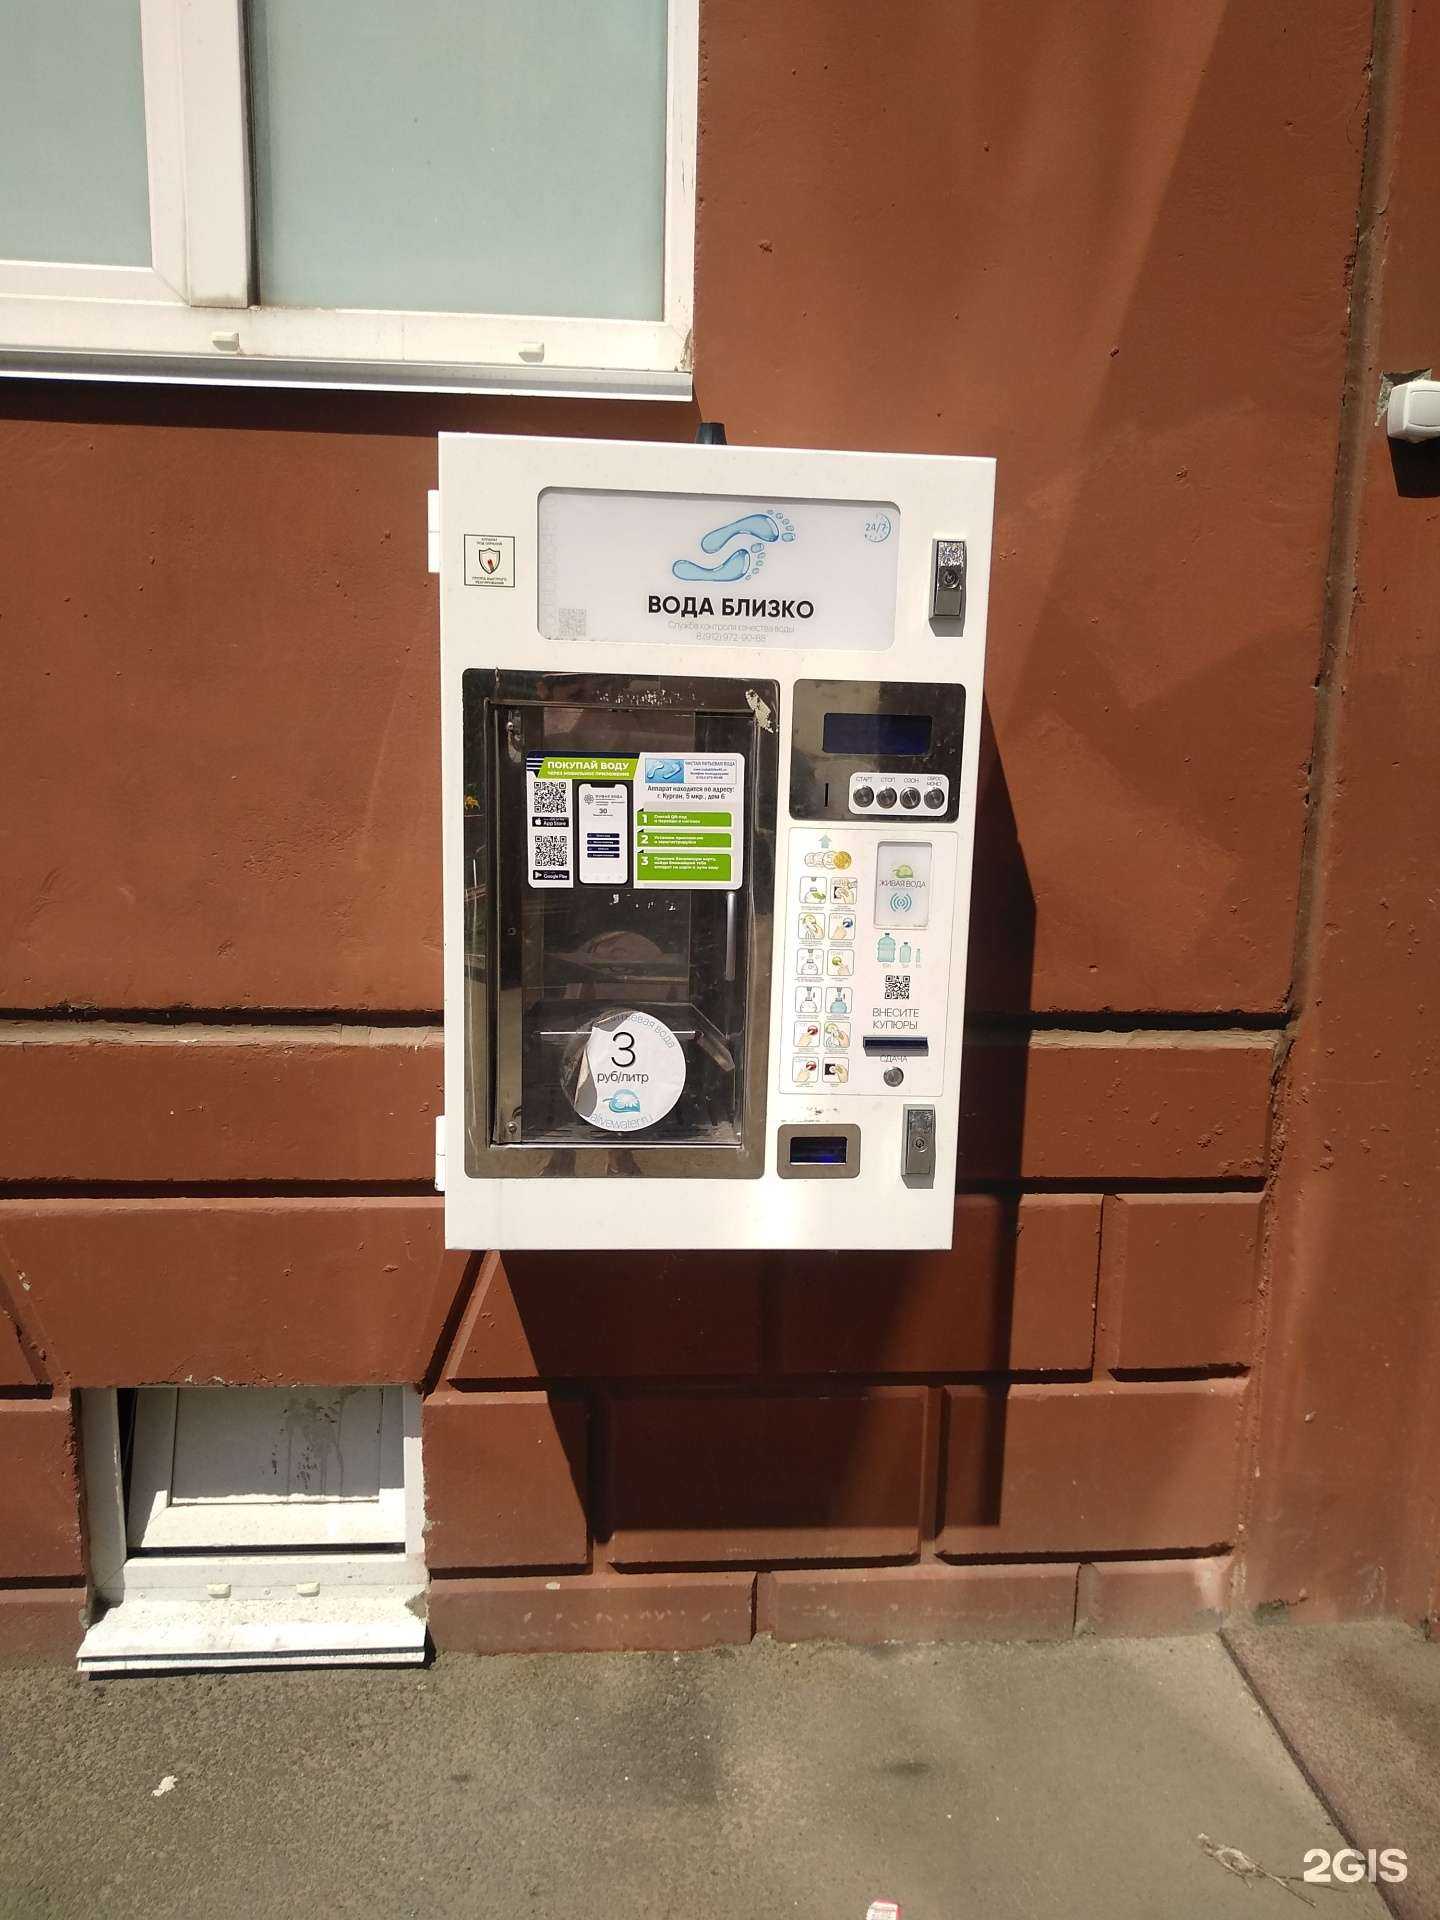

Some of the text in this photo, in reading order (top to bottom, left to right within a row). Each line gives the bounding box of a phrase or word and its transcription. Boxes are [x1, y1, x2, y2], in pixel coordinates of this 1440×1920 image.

[865, 522, 888, 533] 24/7
[648, 595, 815, 619] ВОДА БЛИЗКО
[547, 760, 630, 771] ПОКУПАЙ ВОДУ
[641, 815, 648, 824] 1
[641, 834, 649, 844] 2
[641, 856, 649, 866] 3
[879, 879, 927, 889] ЖИВАЯ ВОДА
[872, 1007, 920, 1018] ВНЕСИТЕ
[872, 1020, 918, 1030] КУПЮРЫ
[611, 1031, 636, 1068] 3
[880, 1054, 908, 1063] СДАЧА
[597, 1070, 649, 1084] руб/литр
